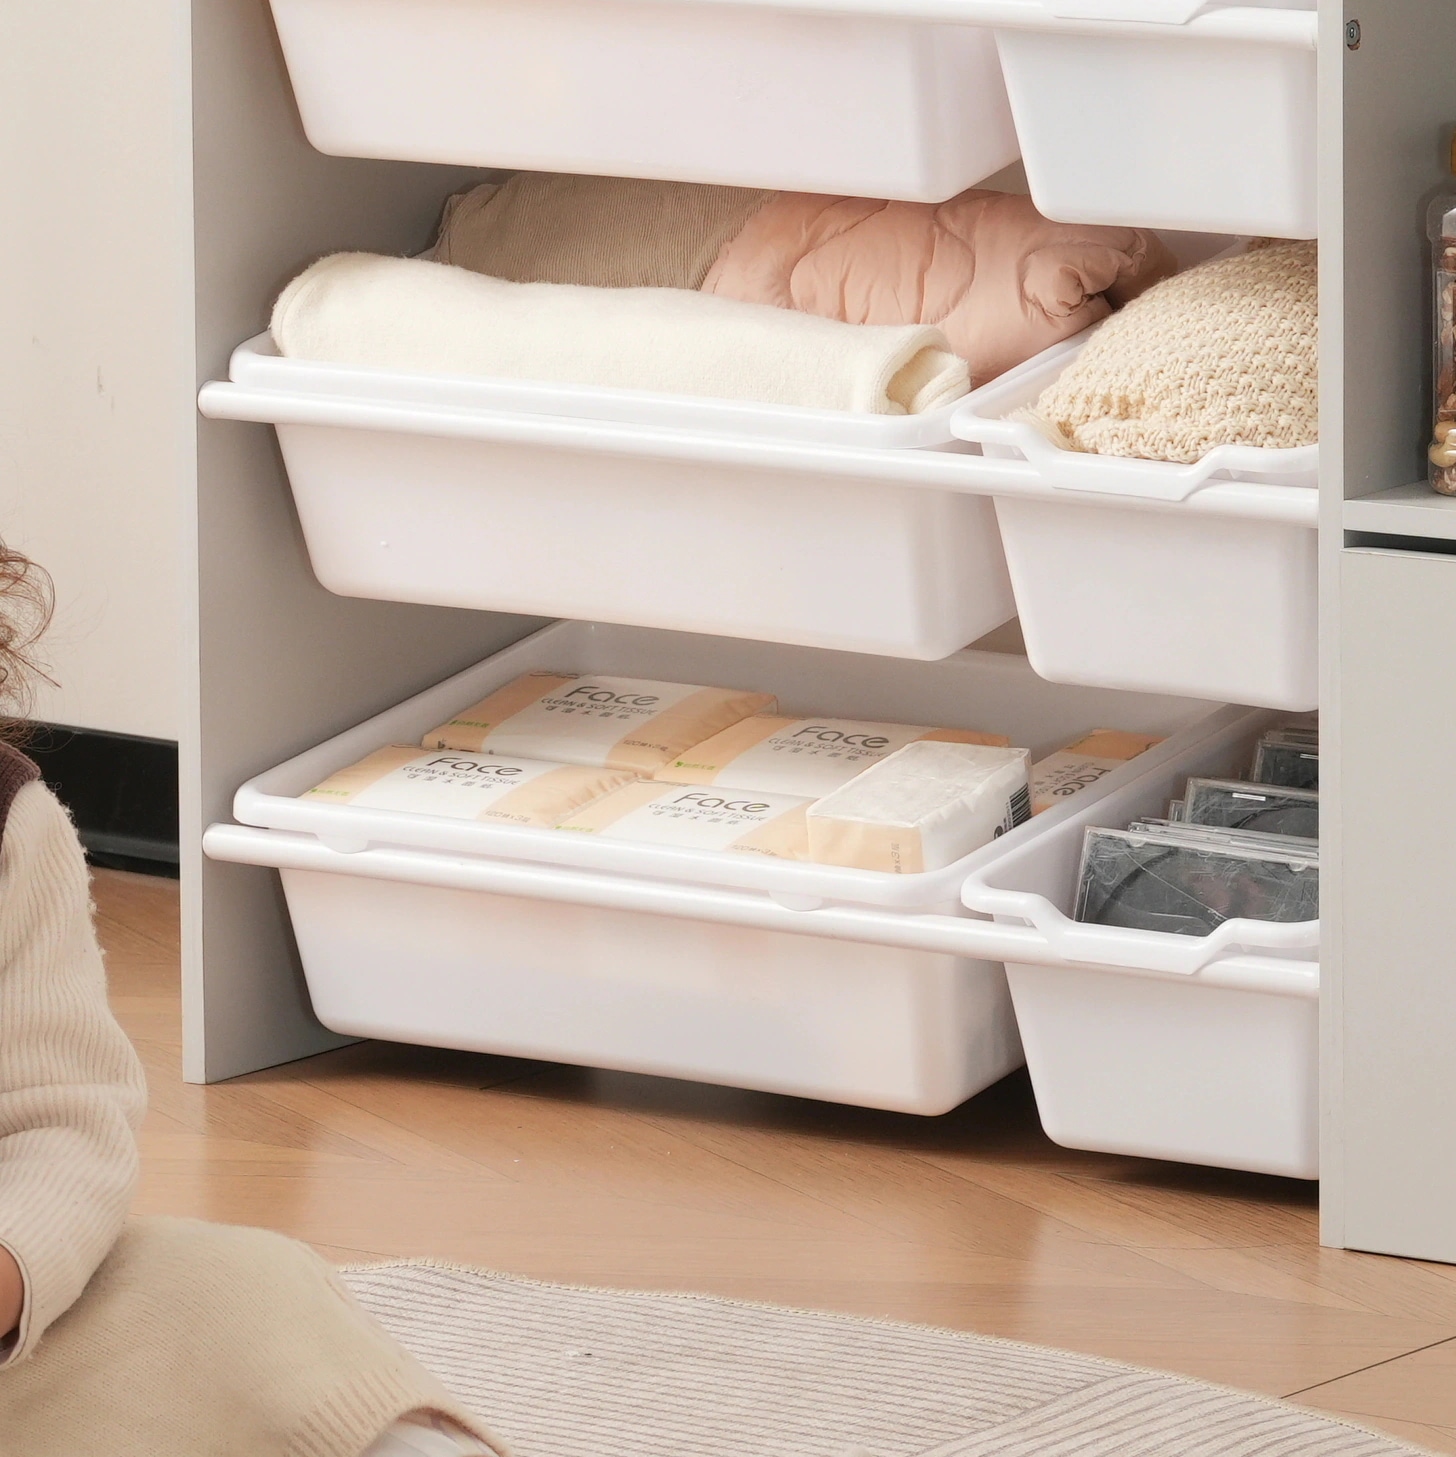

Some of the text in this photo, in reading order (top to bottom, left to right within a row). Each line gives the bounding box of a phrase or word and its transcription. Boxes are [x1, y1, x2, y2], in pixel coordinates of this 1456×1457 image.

[564, 686, 660, 706] Face
[541, 697, 577, 707] CLEAN
[586, 703, 618, 711] SOFT
[618, 706, 658, 716] TISSUE
[792, 726, 889, 749] Face
[403, 765, 439, 776] CLEAN
[448, 771, 480, 780] SOFT
[480, 775, 521, 785] TISSUE
[426, 757, 523, 776] Face
[673, 792, 770, 813] Face
